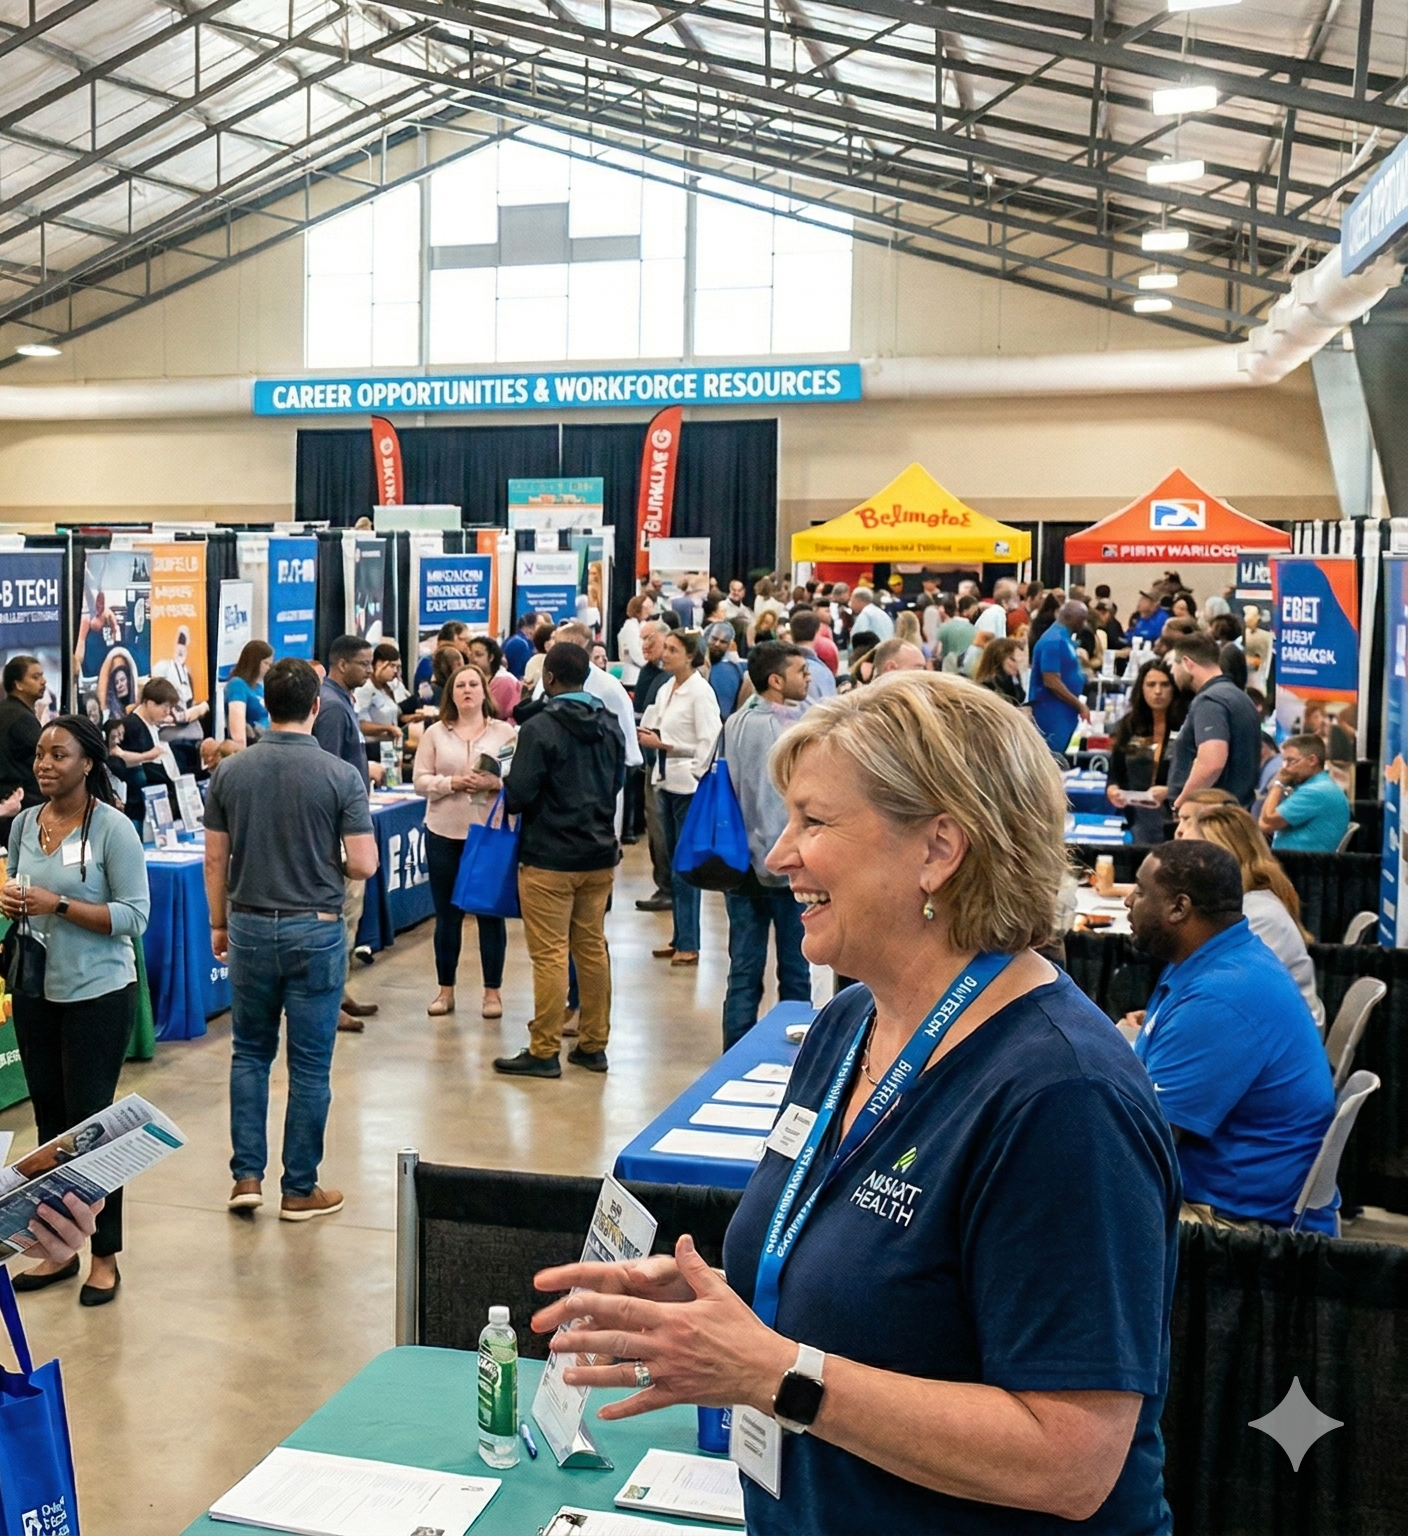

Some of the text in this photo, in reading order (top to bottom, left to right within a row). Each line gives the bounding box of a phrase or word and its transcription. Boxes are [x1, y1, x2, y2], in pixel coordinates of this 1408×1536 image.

[272, 369, 842, 410] CAREER OPPORTUNITIES & WORKFORCE RESOURCES
[15, 579, 58, 606] TECH
[849, 1186, 914, 1227] HEALTH
